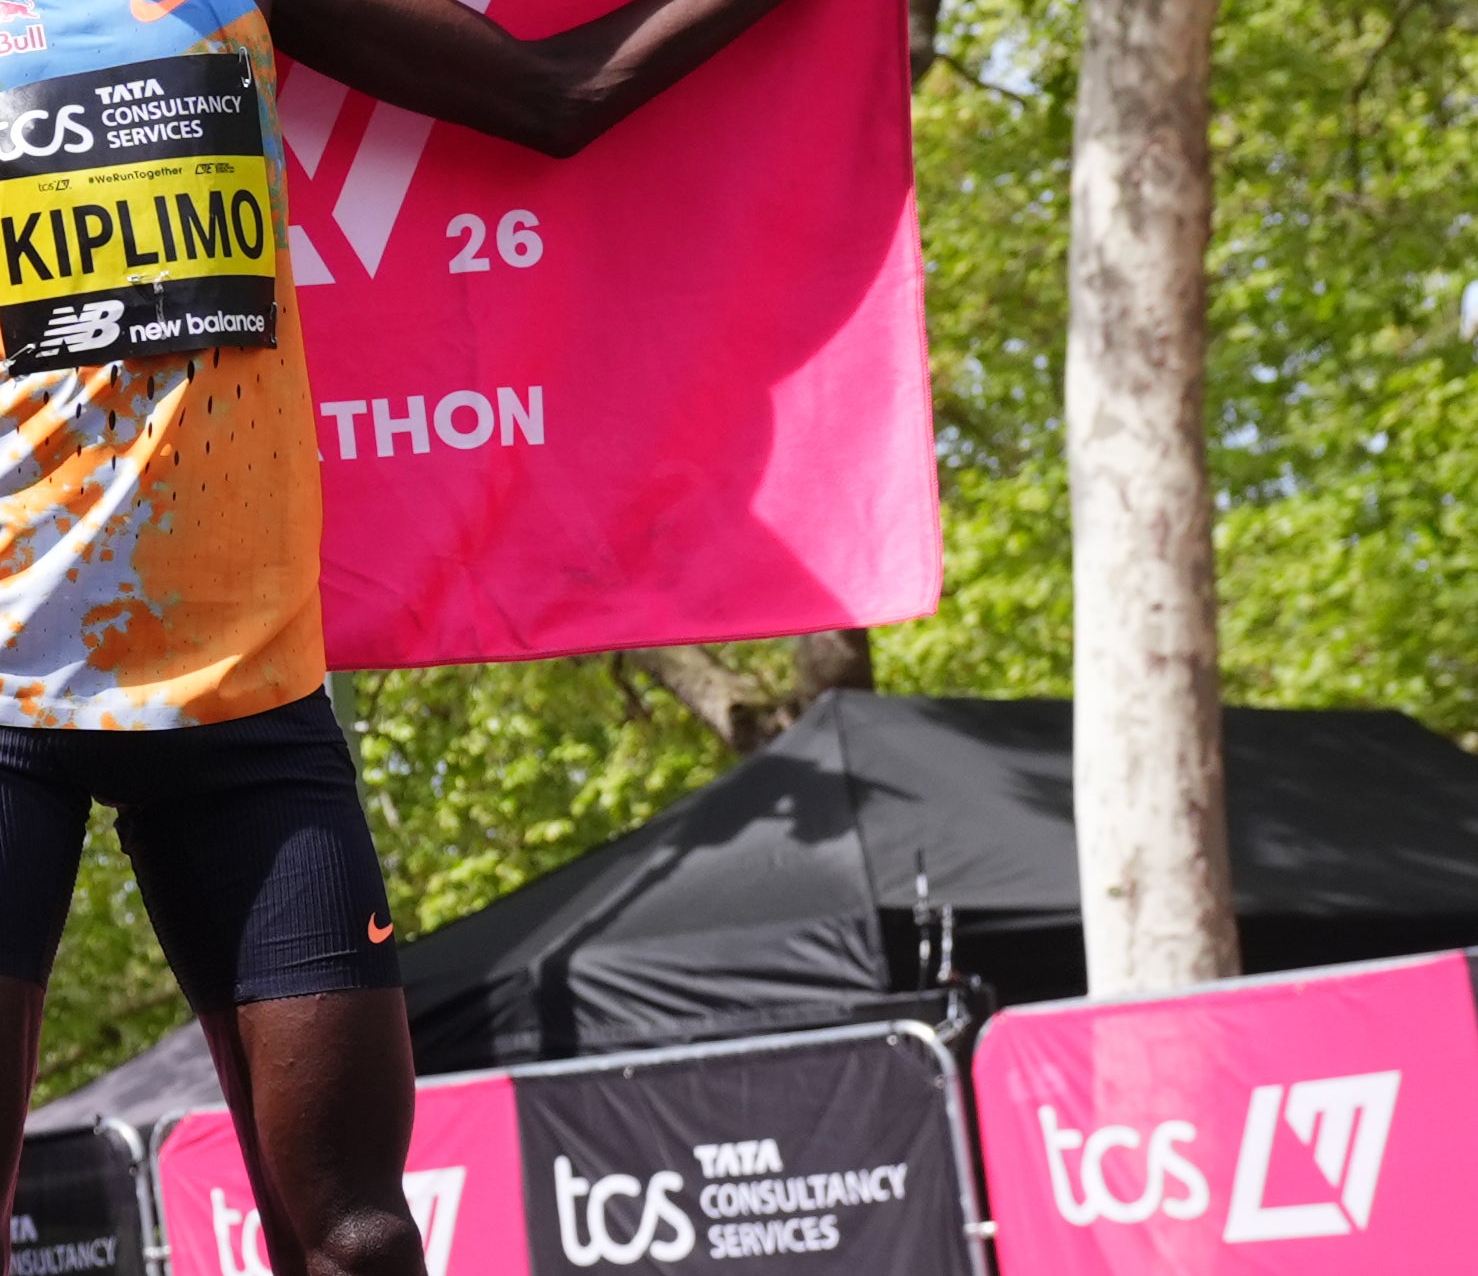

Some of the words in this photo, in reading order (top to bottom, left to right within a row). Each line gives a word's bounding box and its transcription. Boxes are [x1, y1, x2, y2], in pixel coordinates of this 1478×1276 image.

[95, 78, 165, 105] TATA
[101, 94, 243, 129] CONSULTANCY
[107, 119, 203, 150] SERVICES
[87, 165, 183, 186] #WeRunTogether
[0, 188, 265, 286] KIPLIMO
[446, 209, 544, 274] 26
[129, 319, 182, 344] new
[186, 310, 265, 335] balance
[319, 384, 545, 462] THON
[694, 1138, 784, 1179] TATA
[1037, 1104, 1210, 1228] tcs
[553, 1155, 696, 1267] tcs
[699, 1163, 908, 1219] CONSULTANCY
[707, 1216, 840, 1260] SERVICES
